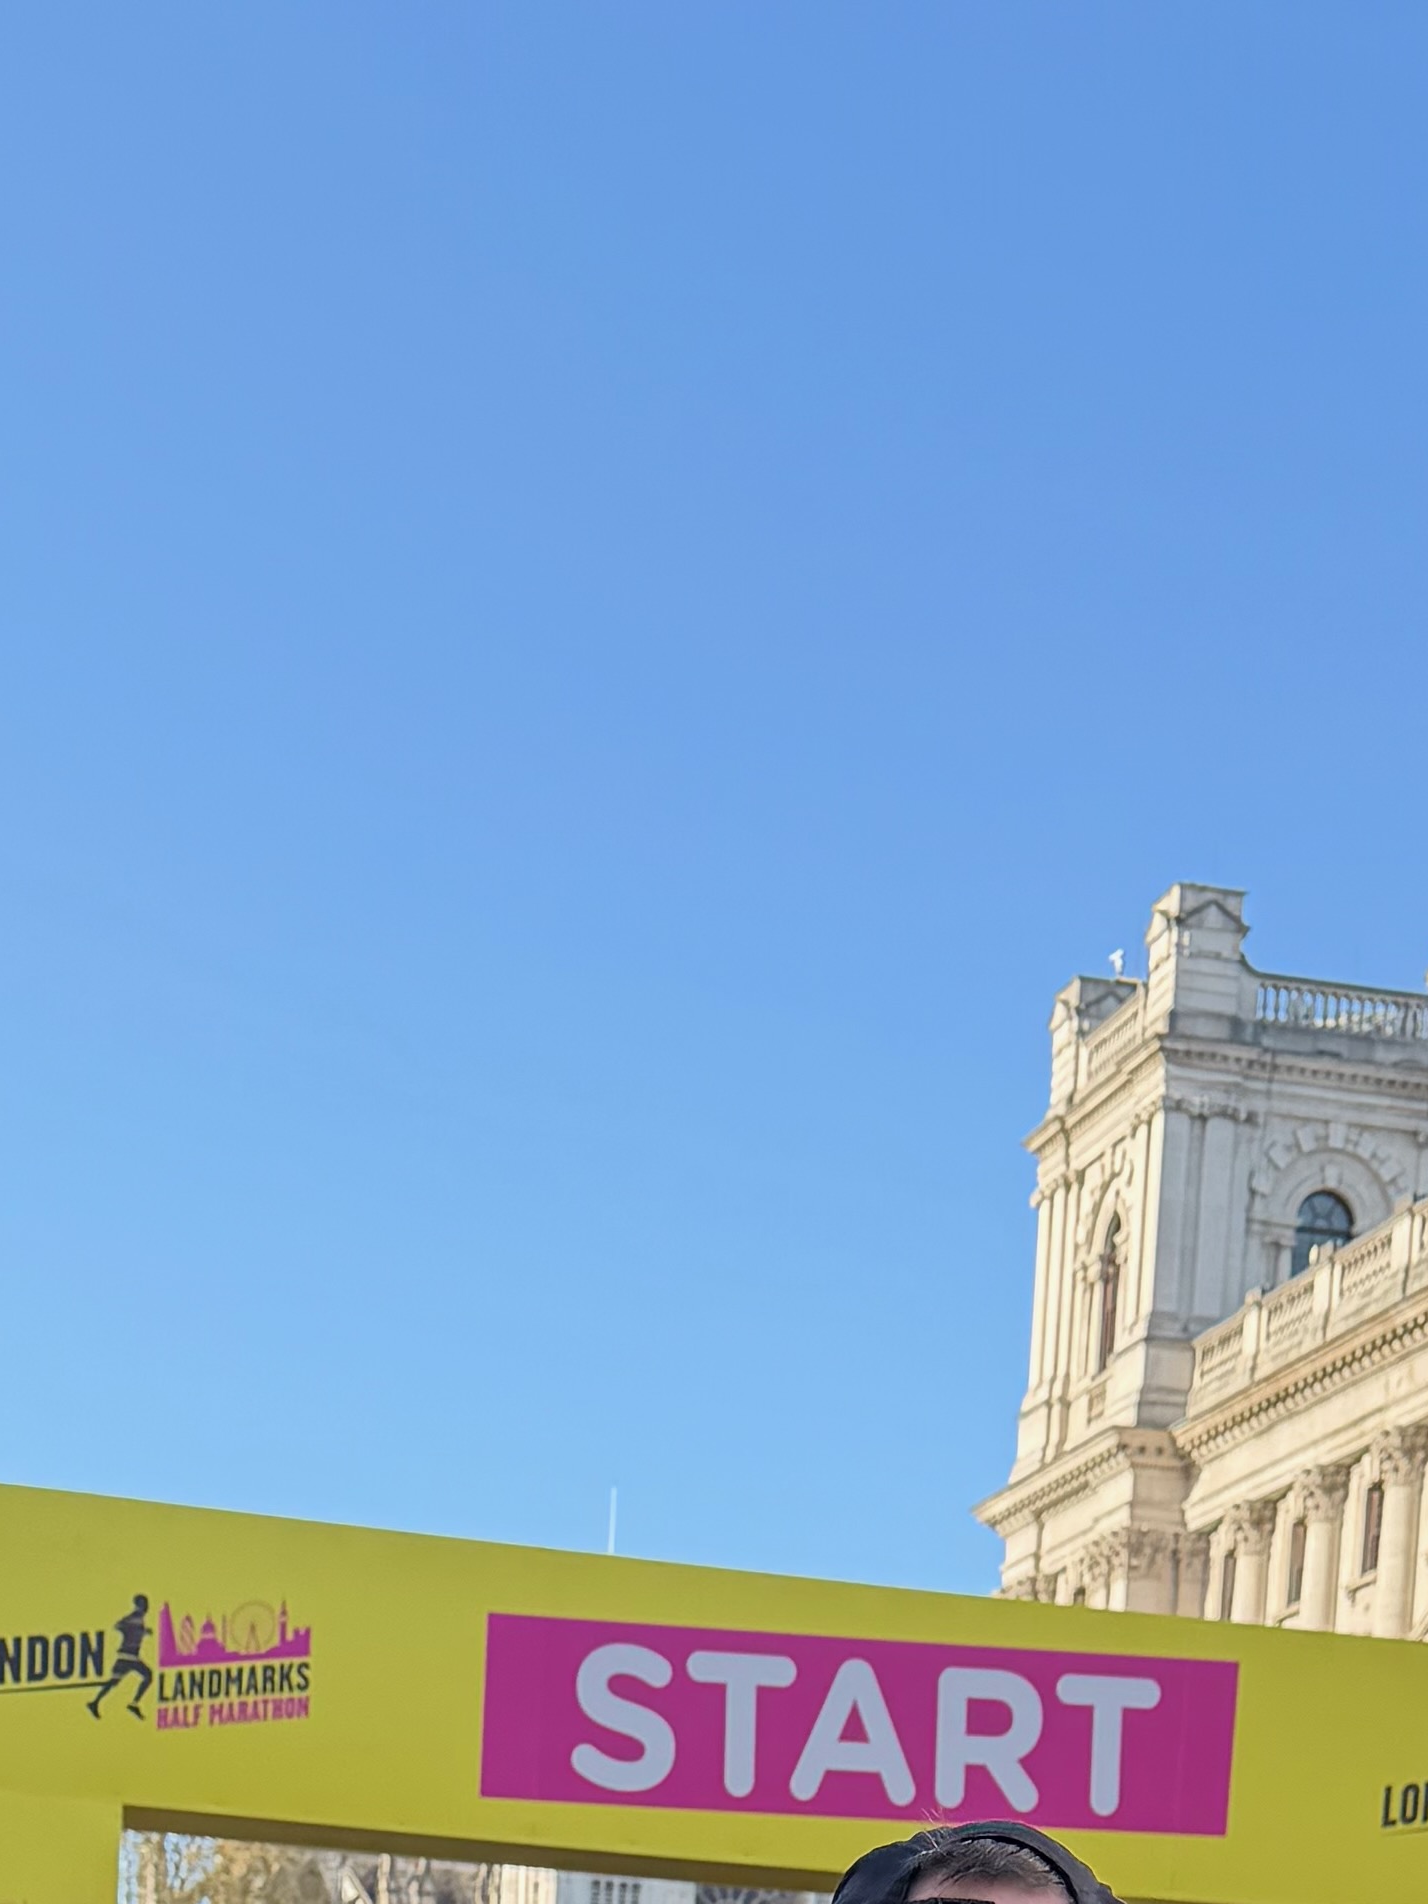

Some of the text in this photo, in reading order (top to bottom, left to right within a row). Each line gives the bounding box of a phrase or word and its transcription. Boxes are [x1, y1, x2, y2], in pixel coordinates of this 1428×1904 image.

[158, 1662, 310, 1702] LANDMARKS
[157, 1696, 310, 1730] HALF MARATHON
[571, 1643, 1162, 1817] START
